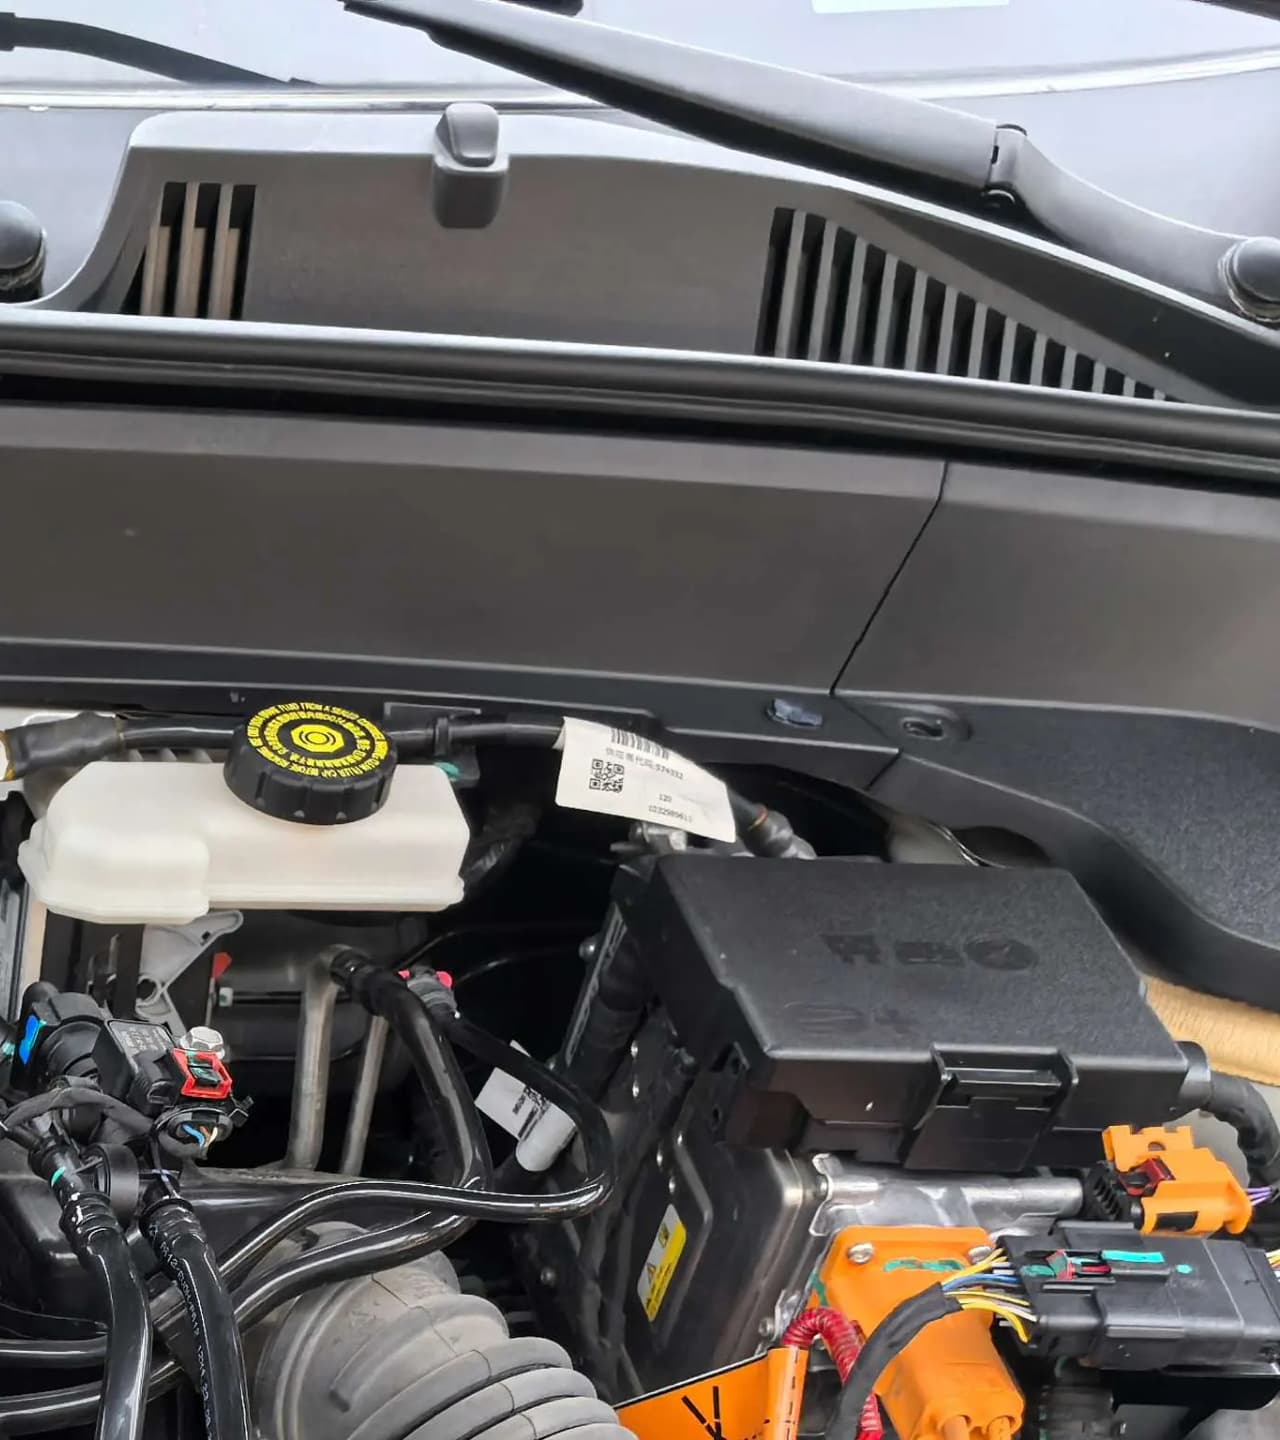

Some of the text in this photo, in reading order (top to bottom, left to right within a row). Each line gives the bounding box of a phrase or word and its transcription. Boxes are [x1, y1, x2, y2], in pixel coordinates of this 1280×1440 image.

[279, 703, 300, 712] FLUID
[300, 703, 322, 711] FROM
[289, 763, 319, 775] BEFORE
[338, 766, 363, 776] FILLER
